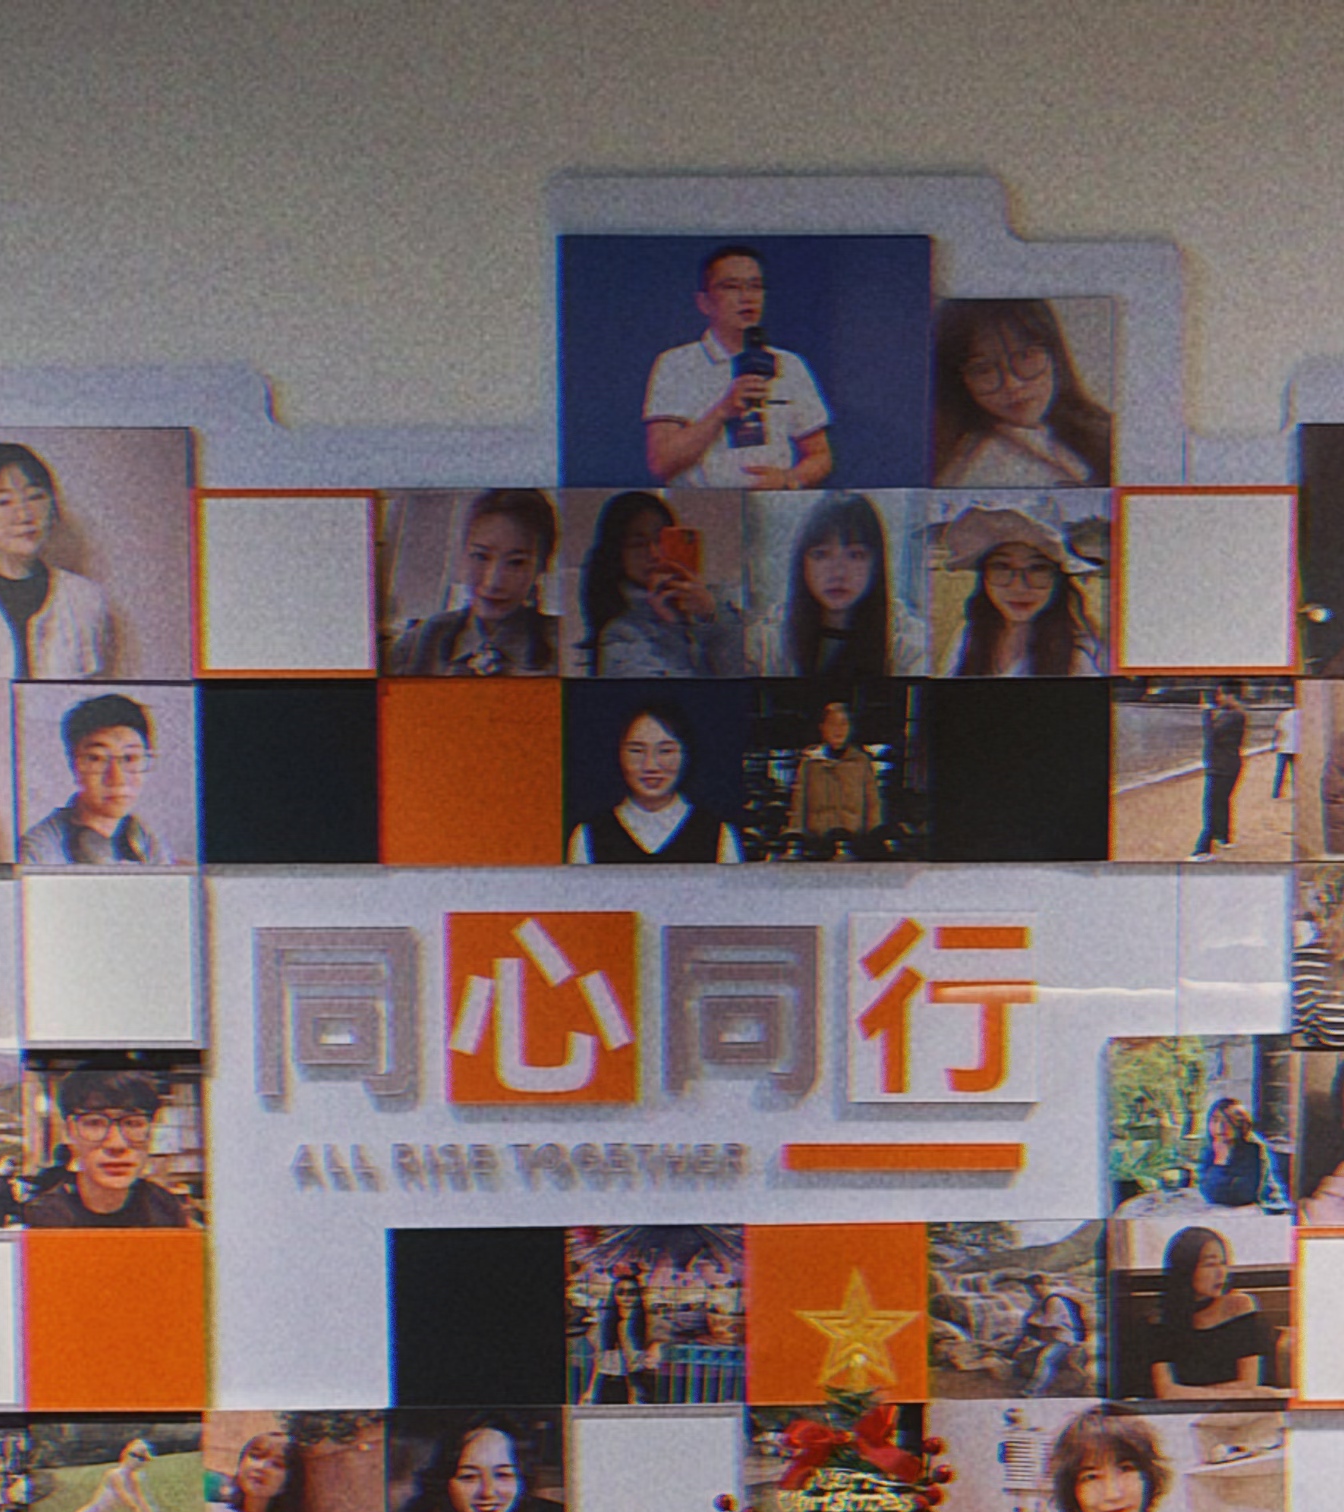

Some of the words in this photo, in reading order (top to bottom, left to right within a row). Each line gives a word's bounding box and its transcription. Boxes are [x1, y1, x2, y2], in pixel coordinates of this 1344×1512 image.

[251, 917, 1037, 1100] 同心同行
[290, 1143, 380, 1182] ALL
[390, 1143, 501, 1182] RISE
[506, 1143, 751, 1182] TOGETHER
